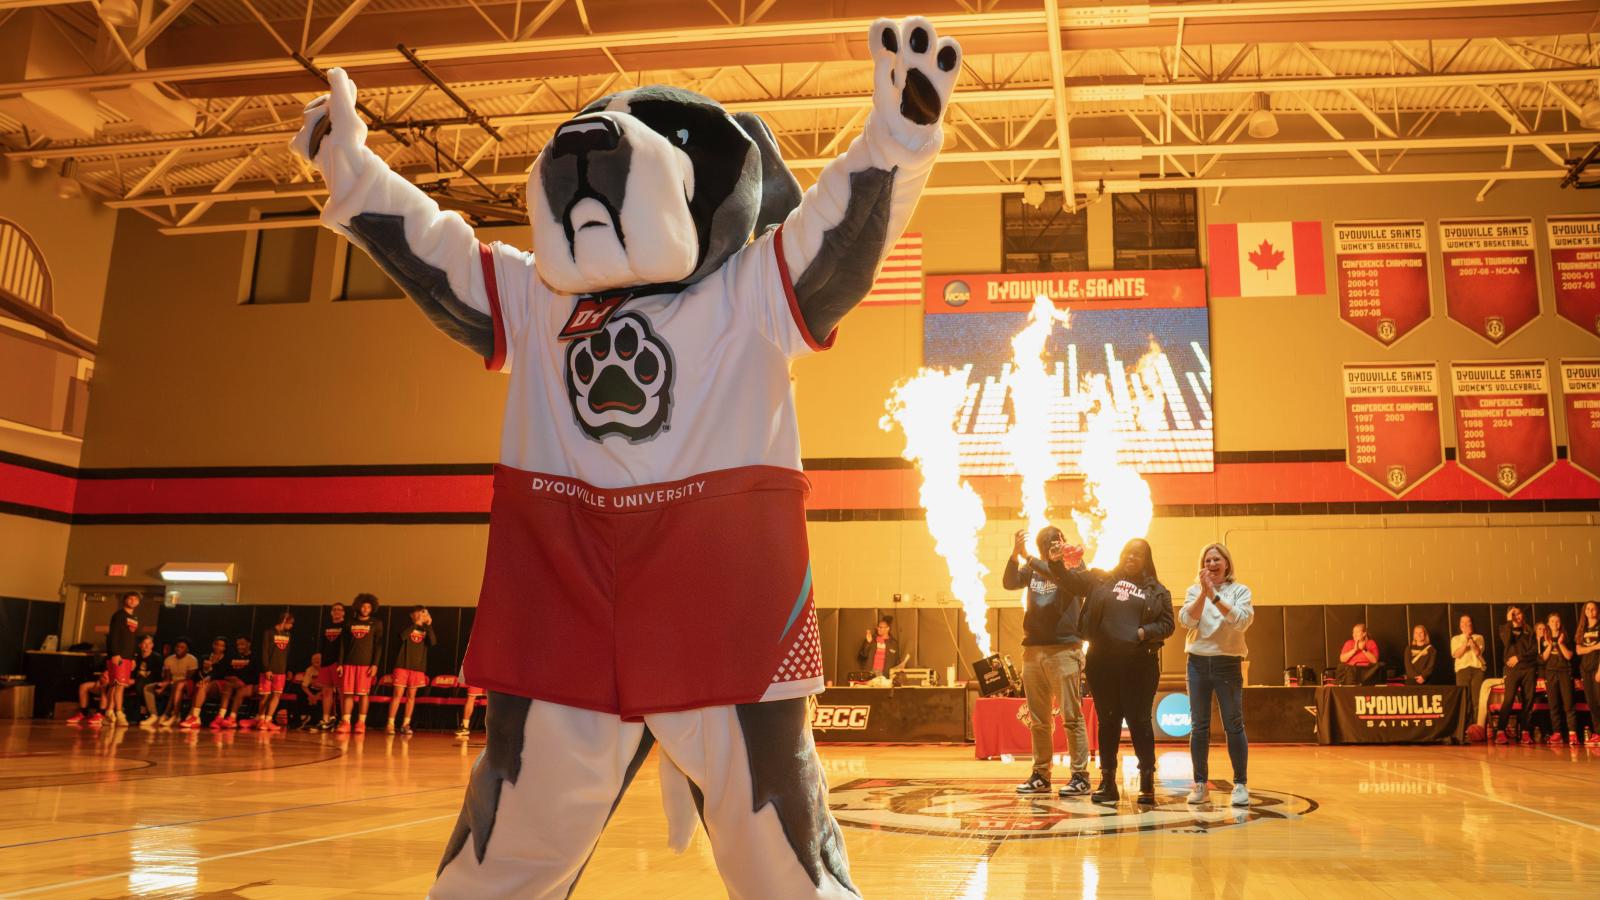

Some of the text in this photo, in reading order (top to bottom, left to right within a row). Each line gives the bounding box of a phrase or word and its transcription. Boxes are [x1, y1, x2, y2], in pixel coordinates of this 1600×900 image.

[1341, 242, 1422, 250] WOMEN'S BASKETBALL
[1447, 239, 1529, 248] WOMEN'S BASKETBALL
[1554, 238, 1590, 246] WOMEN'S
[1342, 258, 1423, 269] CONFERENCE CHAMPIONS
[1485, 256, 1528, 265] TOURNAMENT
[1496, 267, 1520, 275] NCAA
[1347, 280, 1379, 288] 2000-01
[944, 293, 970, 302] NCAA
[1348, 289, 1380, 297] 2001-02
[571, 305, 614, 328] DY
[1349, 384, 1432, 394] WOMEN'S VOLLEYBALL
[1458, 382, 1542, 392] WOMEN'S VOLLEYBALL
[1479, 398, 1524, 407] CONFERENCE
[1351, 402, 1434, 413] CONFERENCE CHAMPIONS
[1459, 408, 1545, 418] TOURNAMENT CHAMPIONS
[1354, 414, 1405, 422] 1997 2003
[1492, 419, 1513, 427] 2024
[1464, 430, 1484, 438] 2000
[1356, 445, 1376, 453] 2000
[1465, 440, 1485, 449] 2003
[1357, 455, 1376, 464] 2001
[532, 477, 706, 509] DYOUVILLE UNIVERSITY
[814, 708, 867, 727] ECC
[1366, 719, 1433, 728] SAINTS
